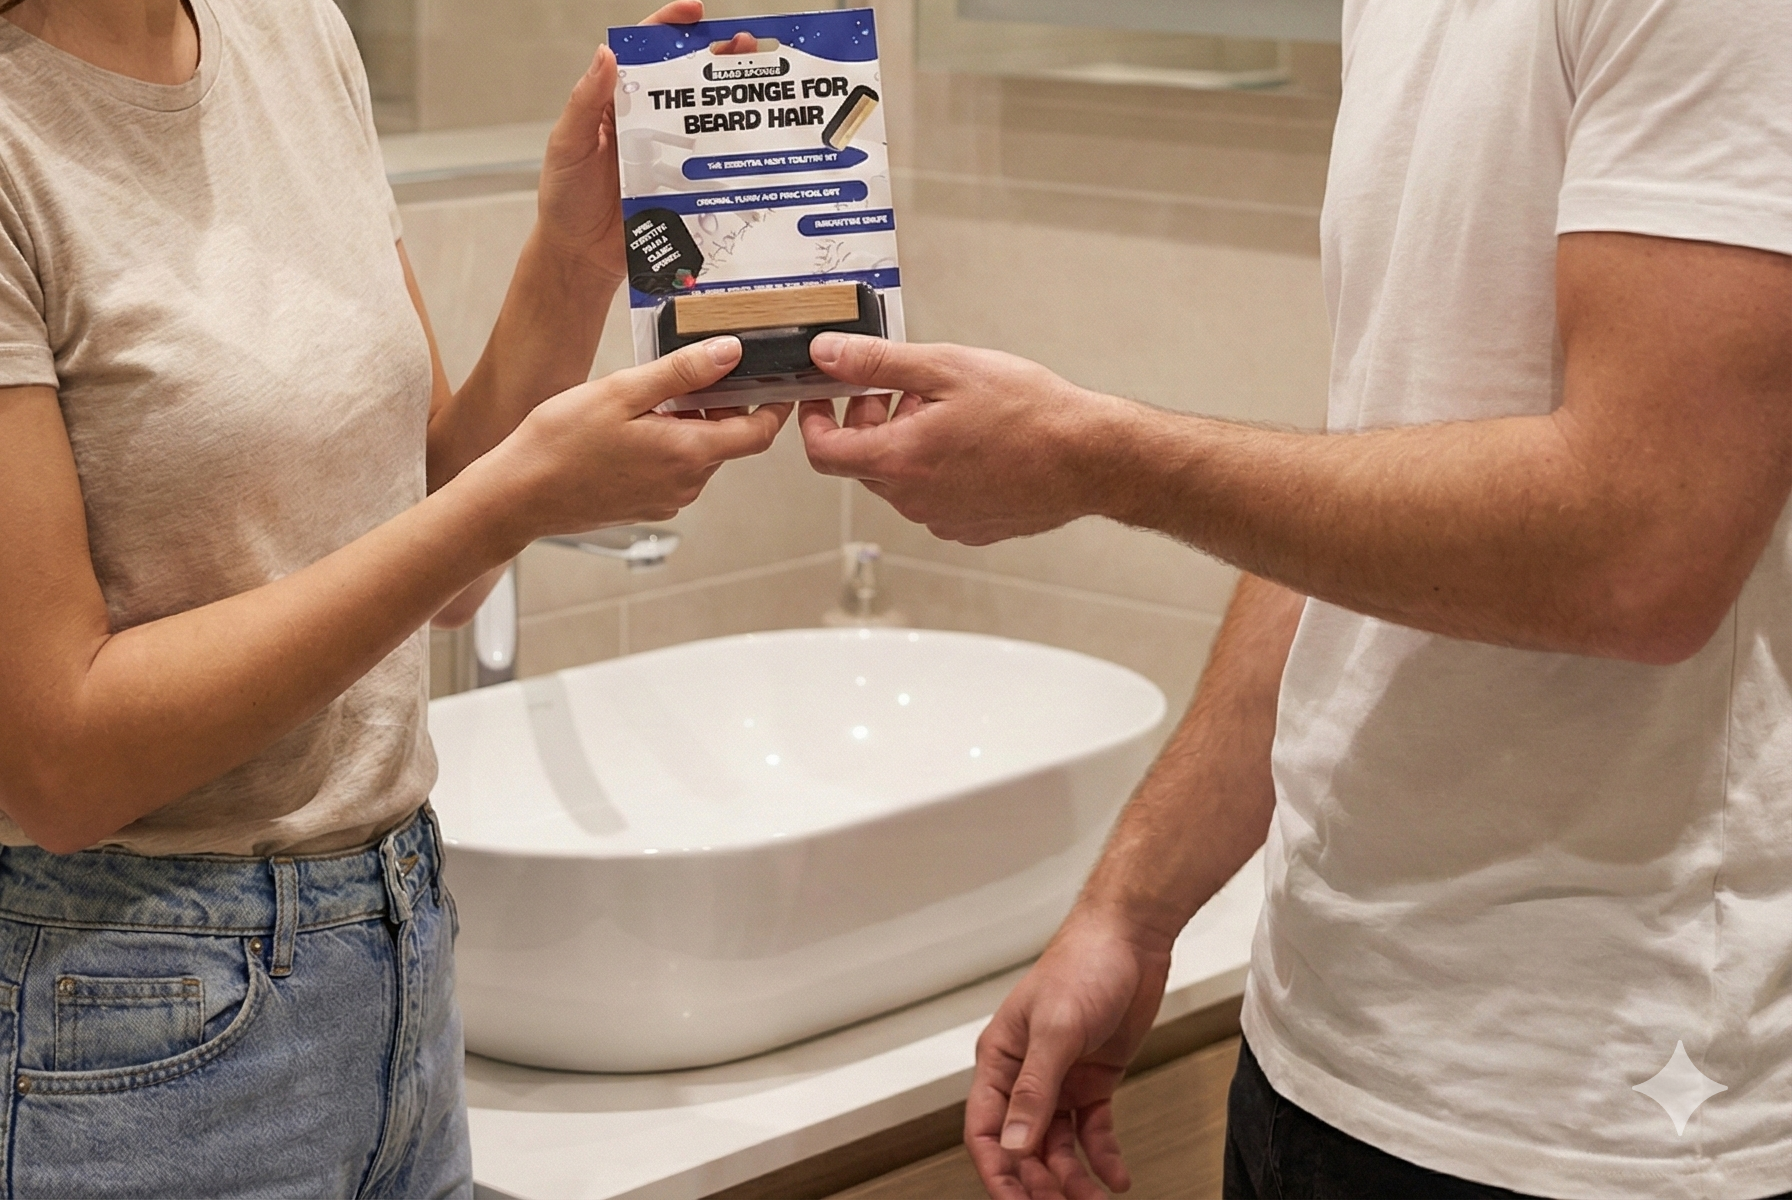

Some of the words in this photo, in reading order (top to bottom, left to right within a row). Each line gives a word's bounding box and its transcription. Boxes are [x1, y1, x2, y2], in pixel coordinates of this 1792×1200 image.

[648, 87, 696, 110] THE
[701, 80, 796, 107] SPONGE
[801, 76, 849, 99] FOR
[684, 109, 762, 134] BEARD
[768, 105, 825, 128] HAIR
